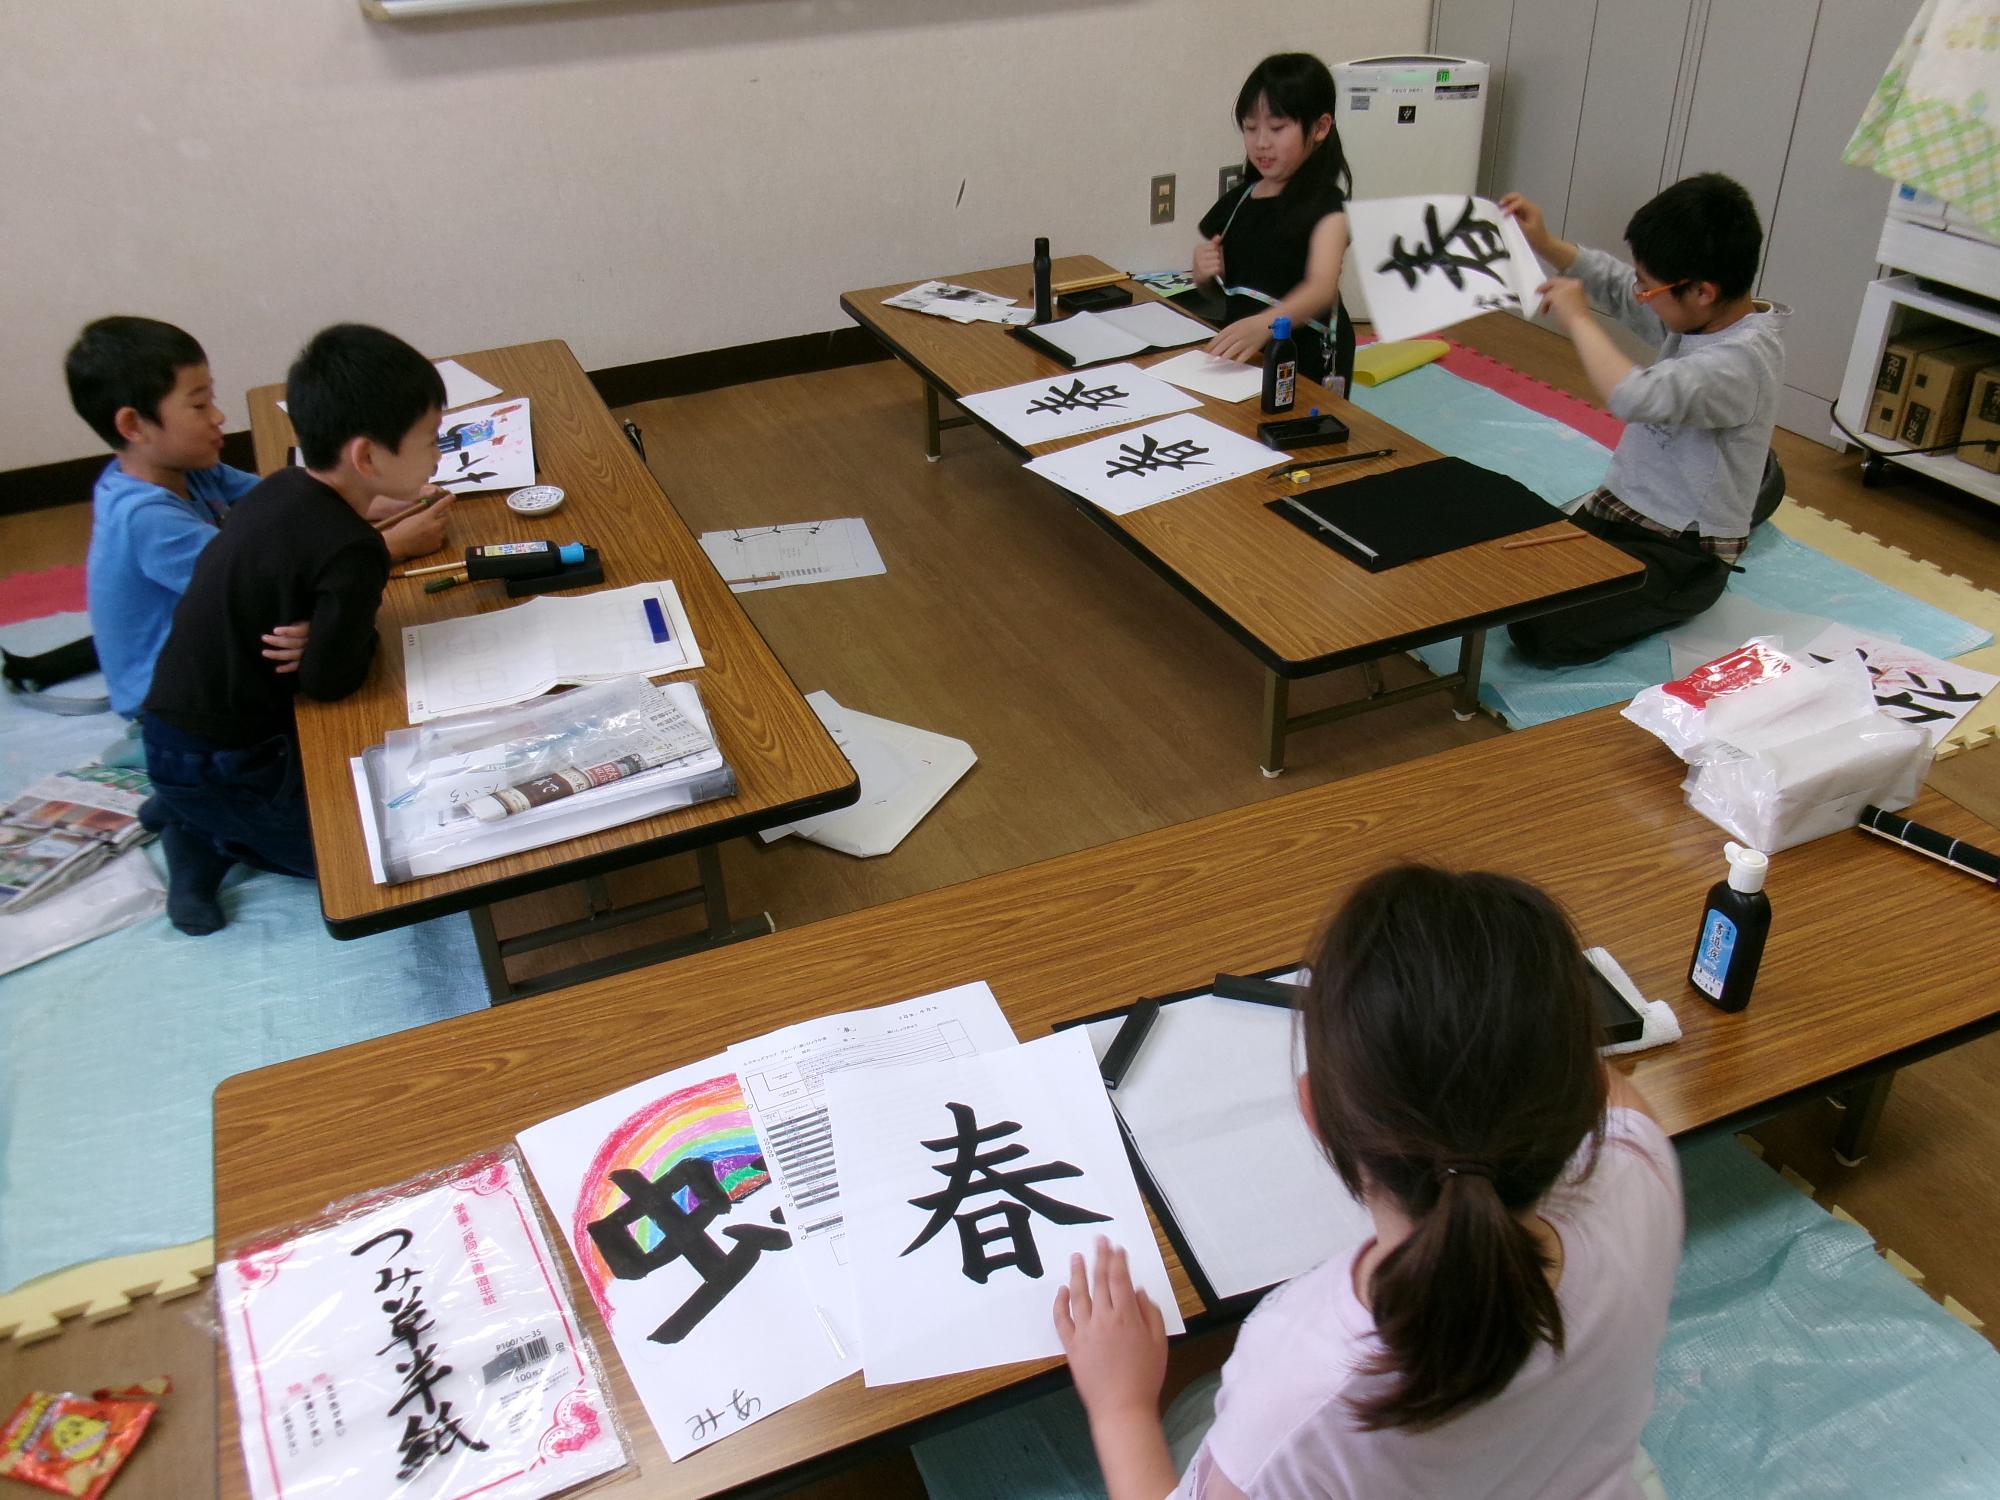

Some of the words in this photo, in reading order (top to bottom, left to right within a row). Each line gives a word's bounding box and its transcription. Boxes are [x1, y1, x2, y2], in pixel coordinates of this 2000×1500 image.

[1025, 377, 1131, 417] 春
[1105, 433, 1215, 479] 春
[901, 1102, 1113, 1284] 春
[350, 1228, 490, 1480] つみ草半紙
